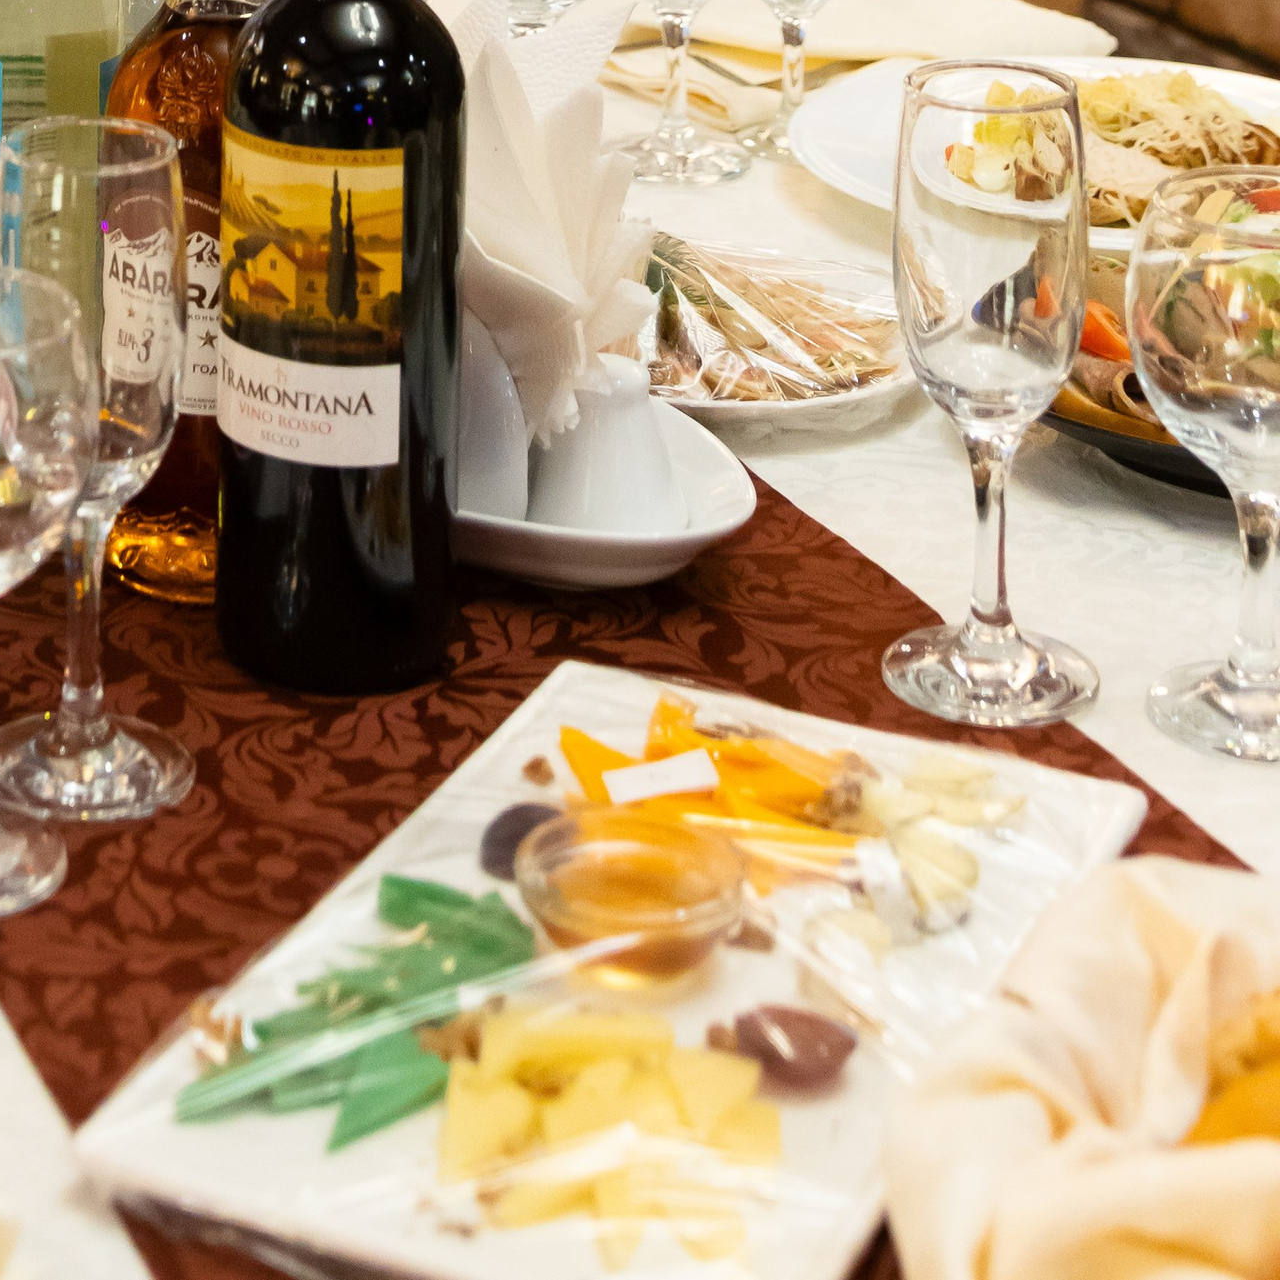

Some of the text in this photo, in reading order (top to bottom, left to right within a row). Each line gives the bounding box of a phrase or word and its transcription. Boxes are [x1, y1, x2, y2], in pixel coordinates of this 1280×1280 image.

[108, 249, 173, 298] ARAR
[187, 313, 220, 321] КОНЬ
[192, 363, 218, 376] ГОД
[221, 356, 374, 416] TRAMONTANA
[238, 399, 332, 435] VINO ROSSO
[260, 429, 300, 449] SECCO
